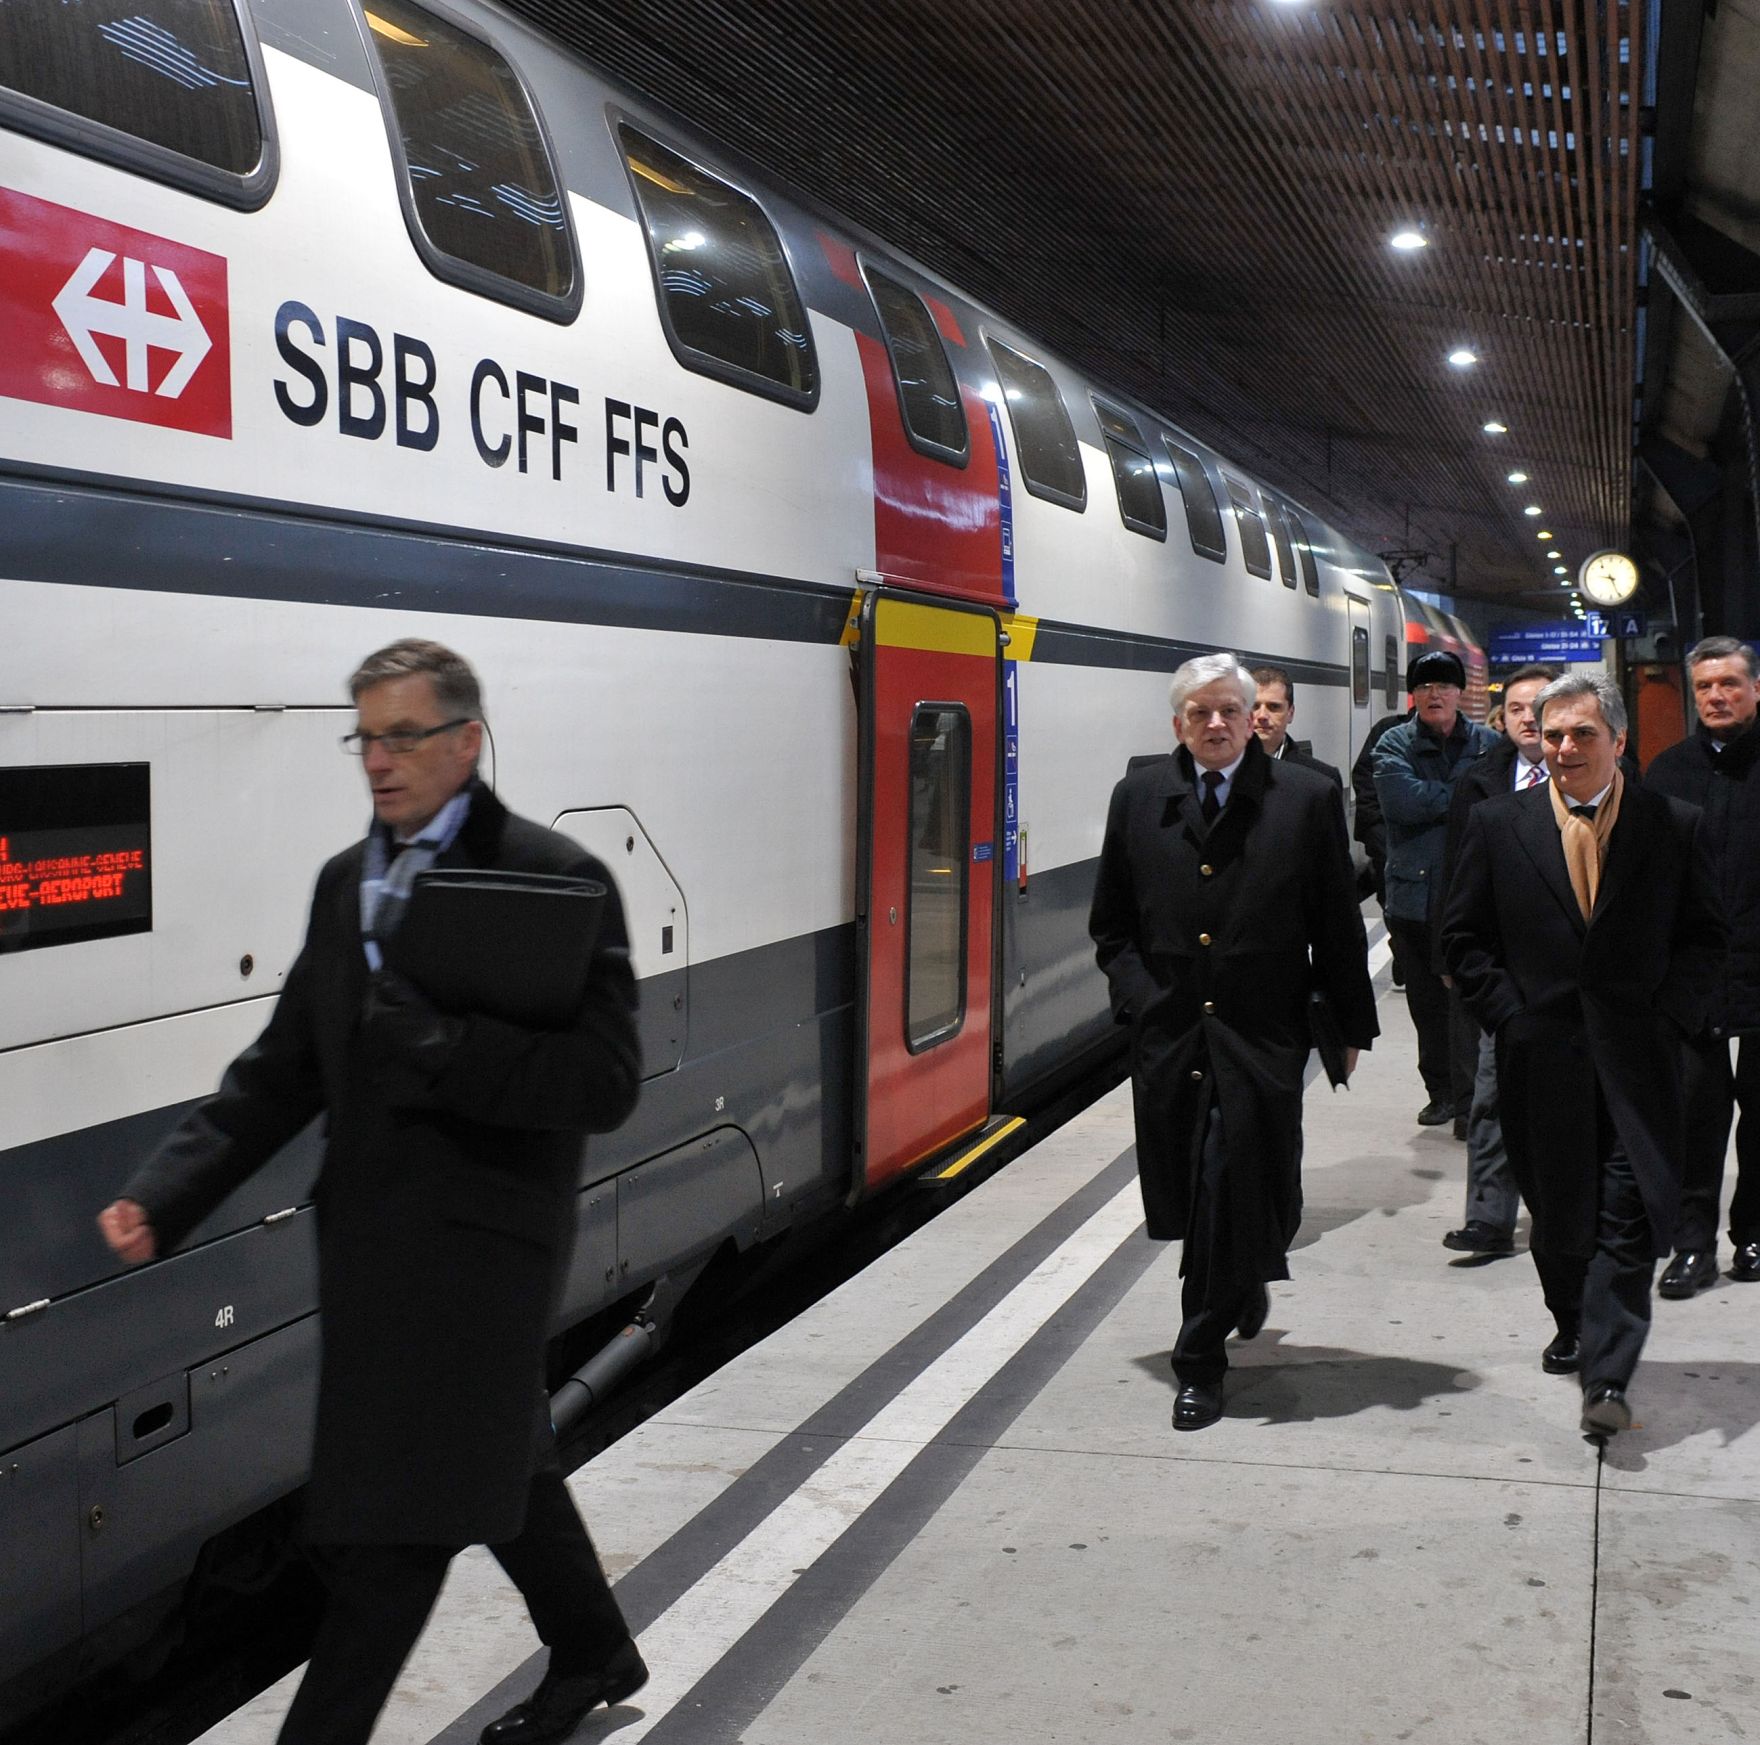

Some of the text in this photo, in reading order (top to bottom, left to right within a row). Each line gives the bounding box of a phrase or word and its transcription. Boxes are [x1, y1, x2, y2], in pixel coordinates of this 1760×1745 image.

[273, 301, 690, 507] SBB CFF FFS
[1591, 619, 1609, 635] 17
[1626, 619, 1639, 634] A
[1007, 671, 1016, 727] 1
[715, 1096, 725, 1112] 3R
[215, 1305, 234, 1328] 4R
